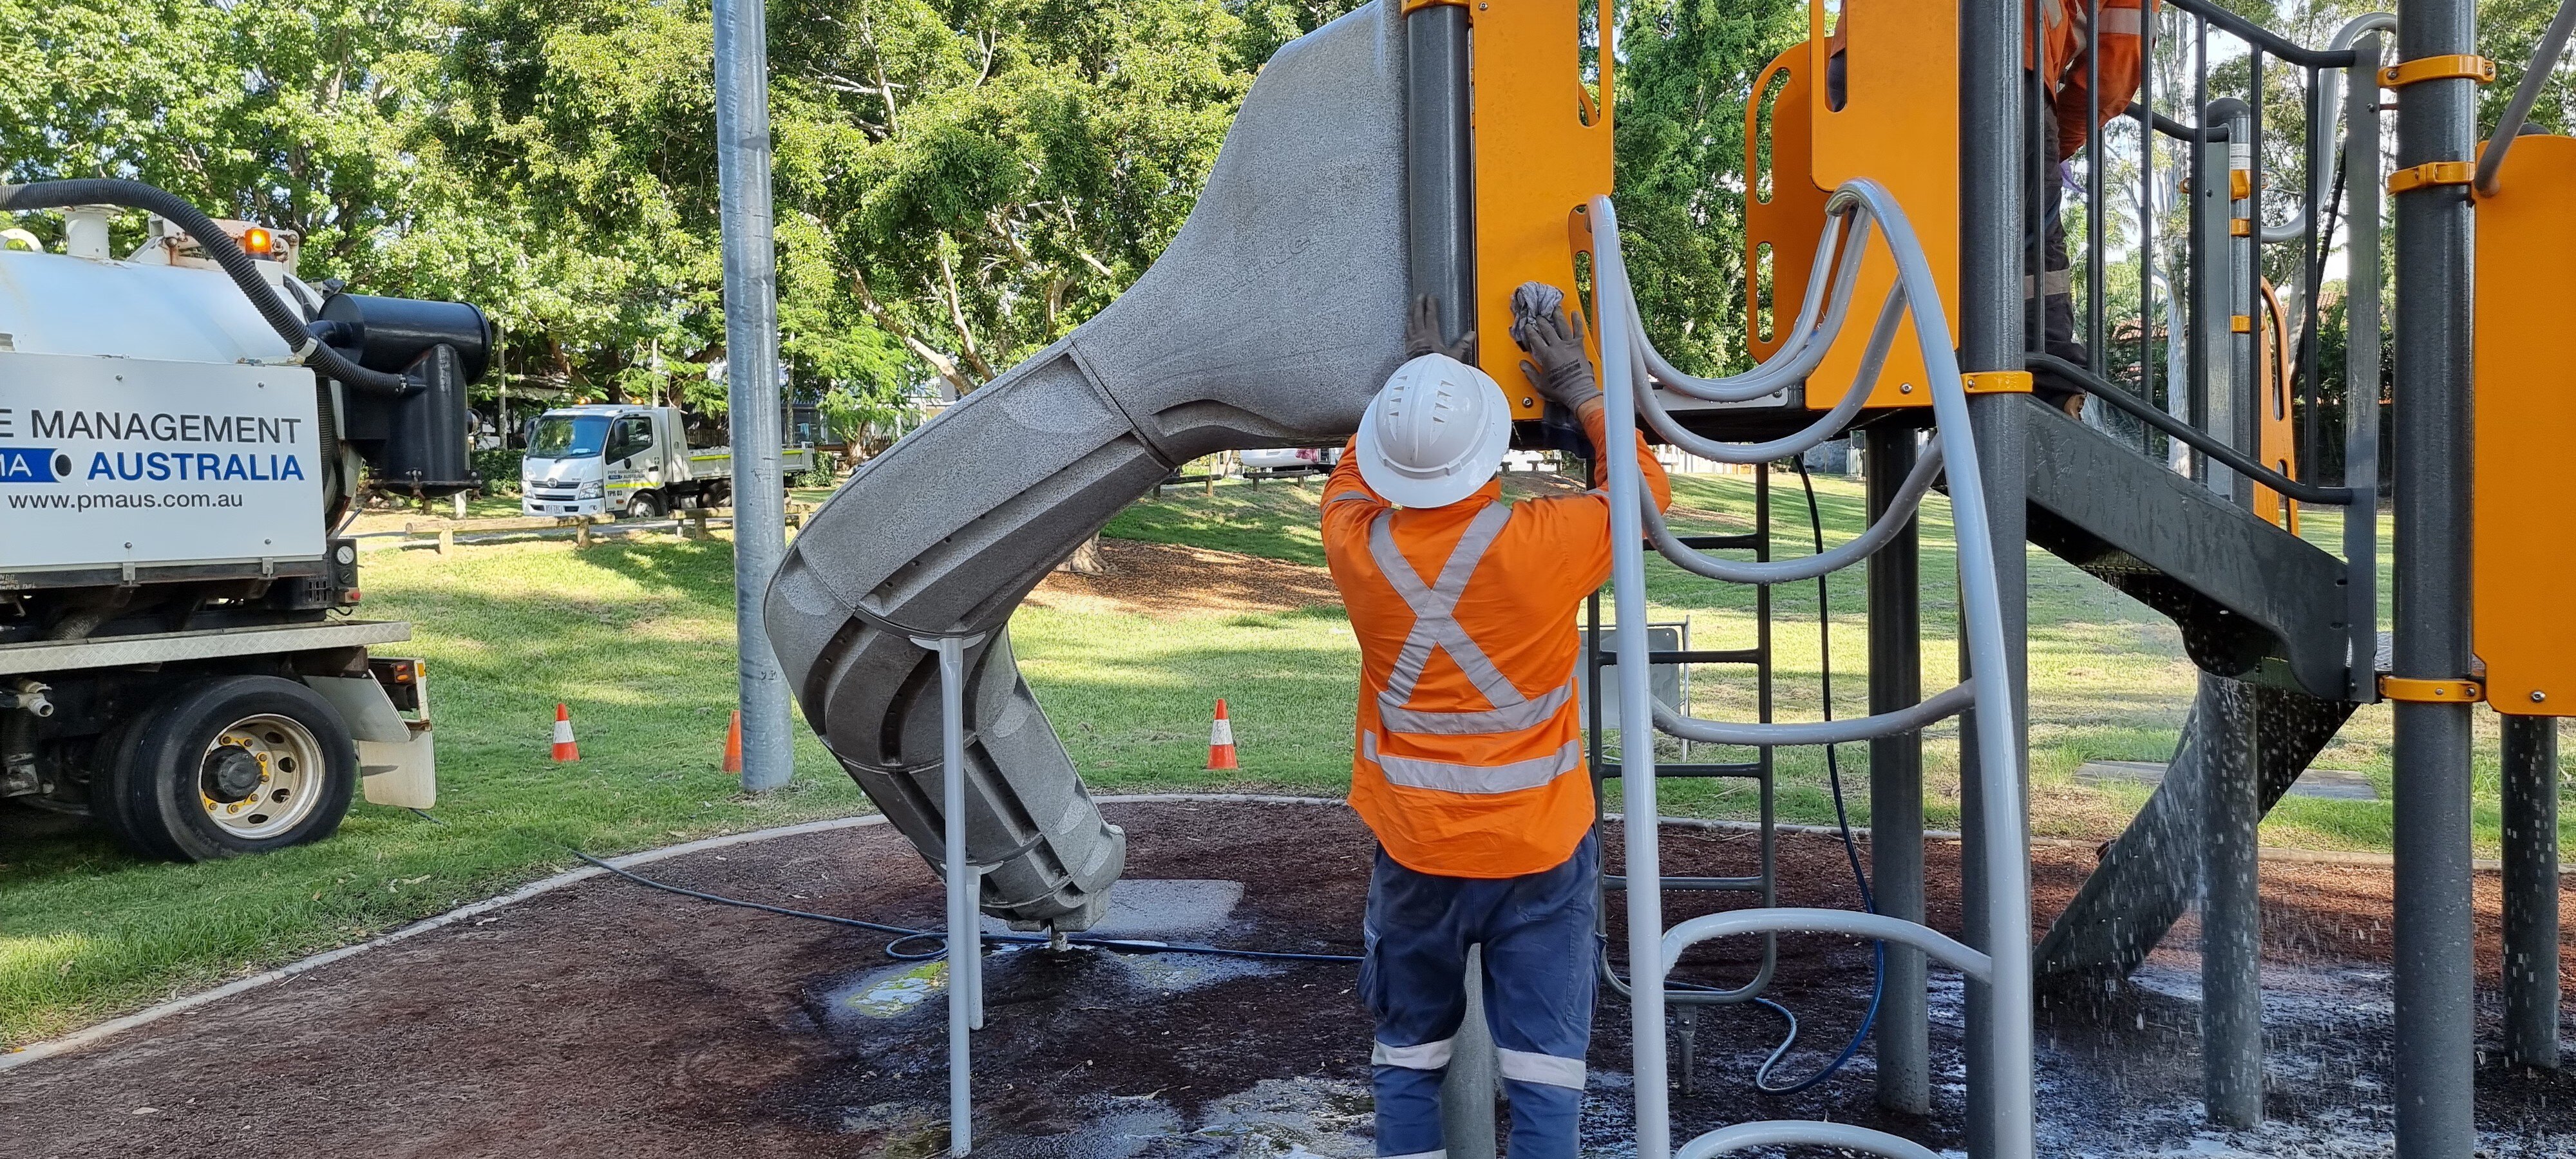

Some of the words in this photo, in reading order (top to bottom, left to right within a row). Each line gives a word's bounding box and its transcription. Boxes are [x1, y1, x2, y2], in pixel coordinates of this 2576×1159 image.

[31, 409, 302, 444] MANAGEMENT
[0, 453, 32, 477] A
[87, 451, 305, 481] AUSTRALIA
[8, 494, 243, 513] www.pmaus.com.au
